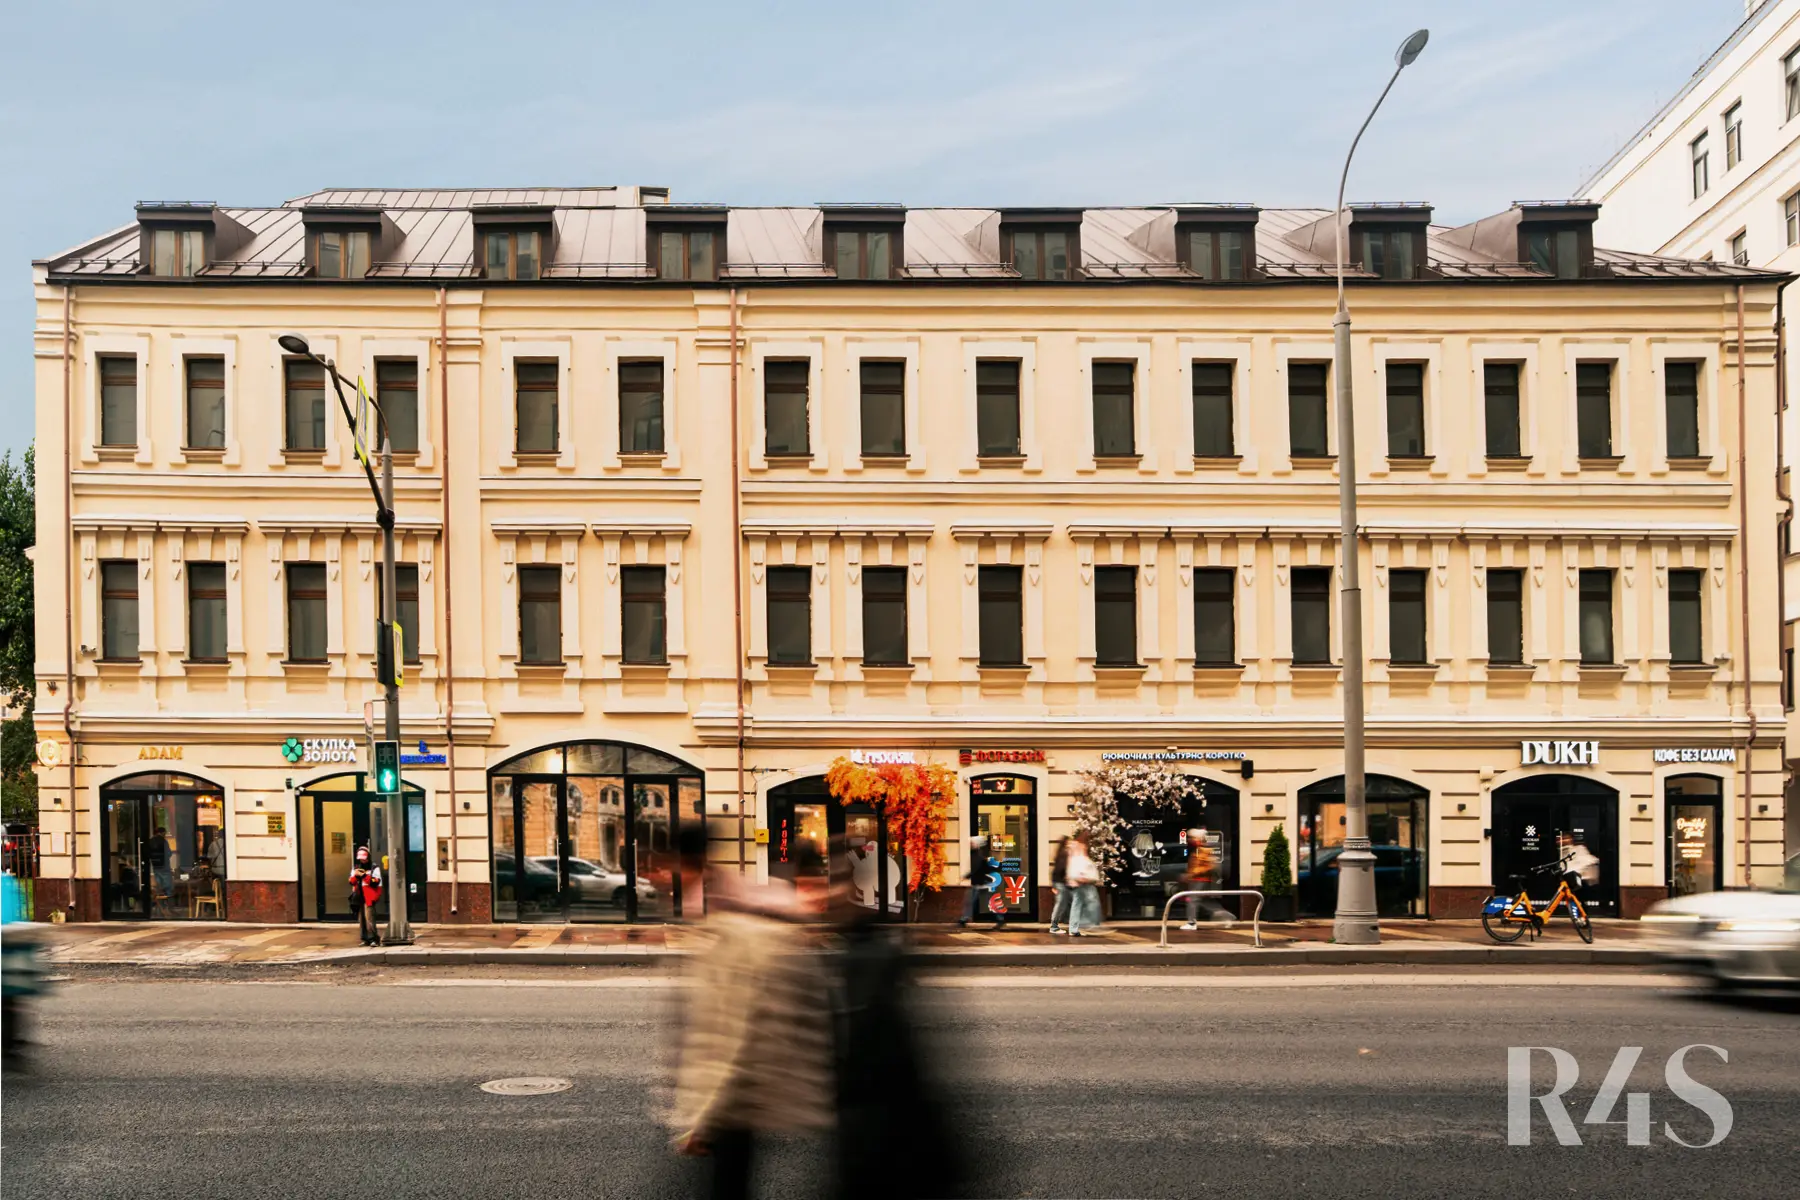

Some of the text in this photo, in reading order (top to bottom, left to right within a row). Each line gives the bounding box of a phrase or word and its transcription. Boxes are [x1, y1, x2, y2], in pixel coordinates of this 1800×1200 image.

[303, 739, 356, 750] СКУПКА
[138, 746, 183, 760] ADAM
[303, 751, 356, 762] ЗОЛОТА
[1155, 752, 1203, 760] КУЛЬТУРНО
[1521, 741, 1599, 764] DUKH
[1655, 749, 1735, 761] КОФЕ БЕЗ САХАРА
